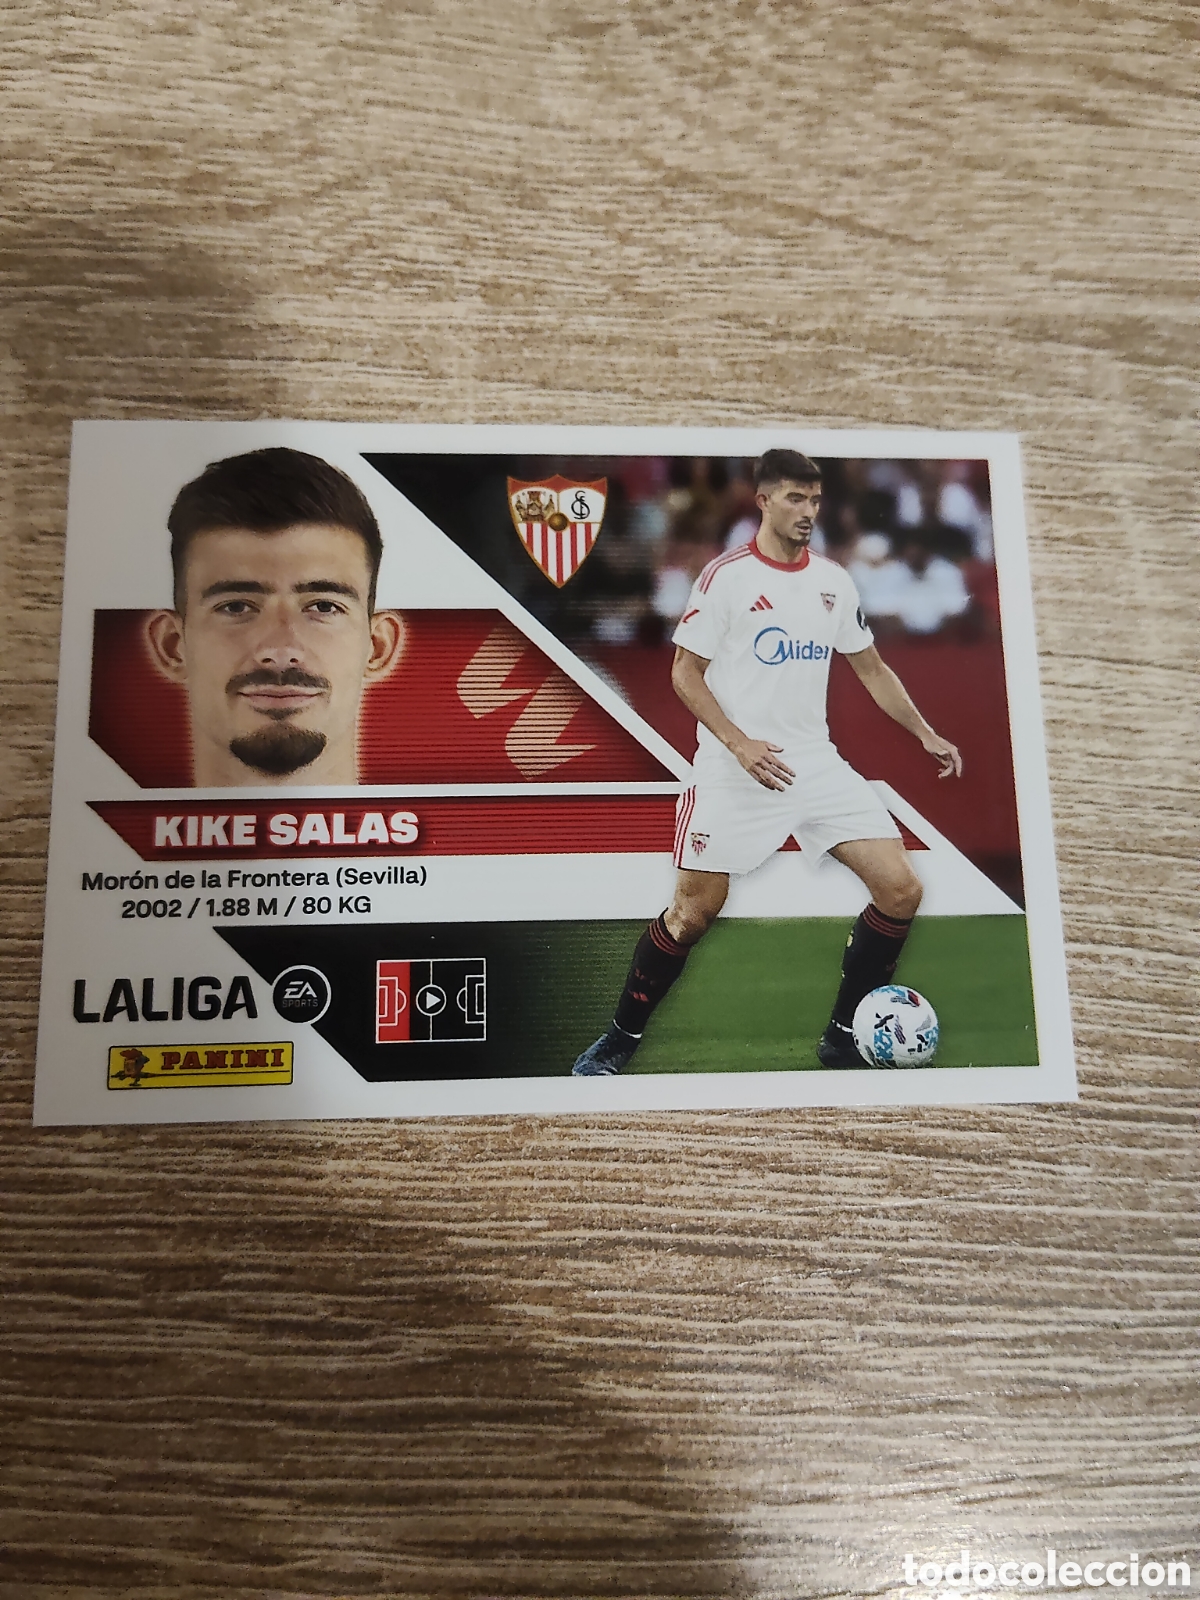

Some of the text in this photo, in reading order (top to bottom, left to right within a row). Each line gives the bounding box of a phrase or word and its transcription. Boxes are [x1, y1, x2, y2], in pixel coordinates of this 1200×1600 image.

[154, 812, 419, 847] KIKE SALAS
[82, 866, 427, 890] Morón de la Frontera (Sevilla)
[122, 896, 372, 918] 2002 / 1.88 M / 80 KG
[73, 976, 258, 1023] LALIGA
[283, 981, 318, 999] EA
[282, 999, 319, 1008] SPORTS
[161, 1049, 284, 1070] PANINI
